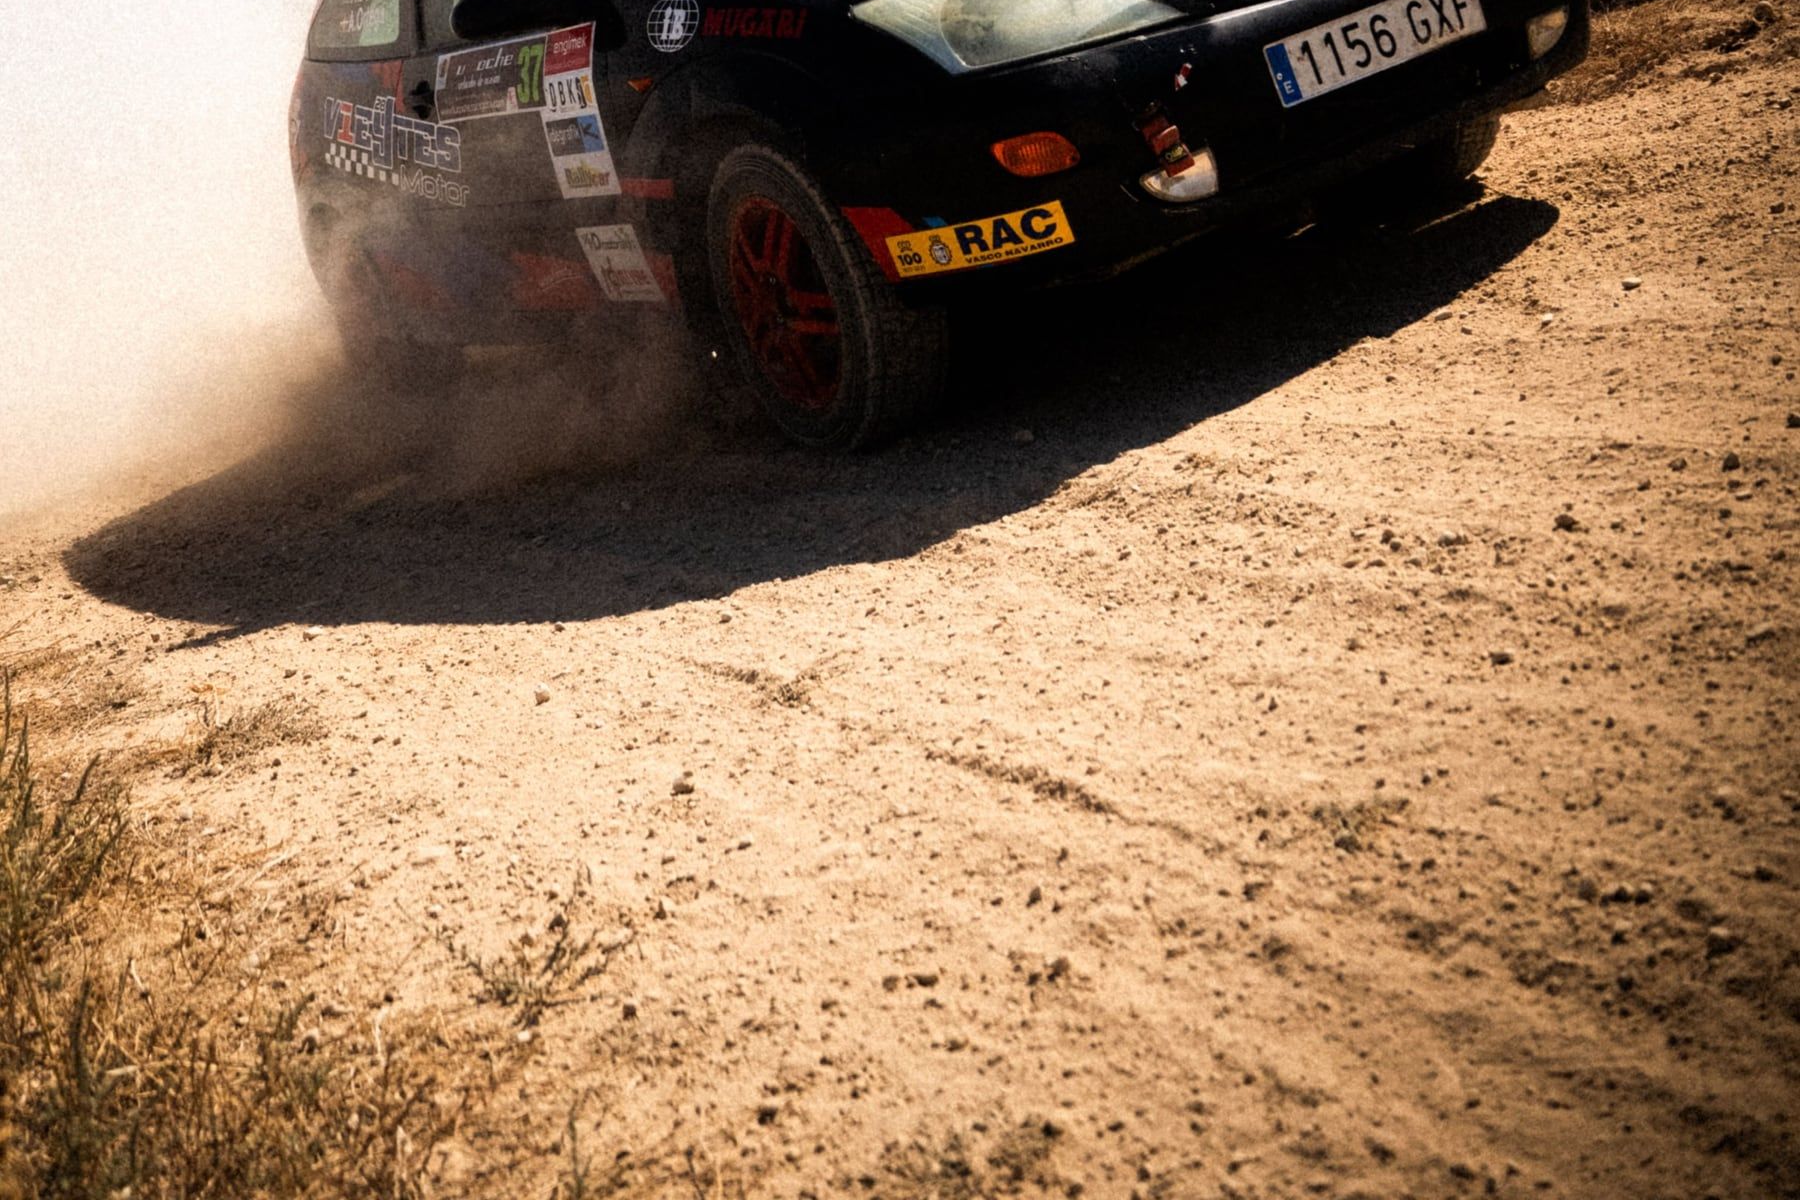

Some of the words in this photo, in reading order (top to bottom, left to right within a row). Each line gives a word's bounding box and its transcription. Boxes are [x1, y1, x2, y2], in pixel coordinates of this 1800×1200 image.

[1300, 13, 1397, 85] 1156
[516, 43, 545, 104] 37
[1283, 80, 1295, 95] E
[323, 95, 462, 173] VIEYTES
[400, 164, 470, 208] Motor
[954, 208, 1058, 256] RAC
[965, 252, 1002, 265] VASCO
[1005, 237, 1064, 257] NAVARRO
[897, 251, 923, 267] 100
